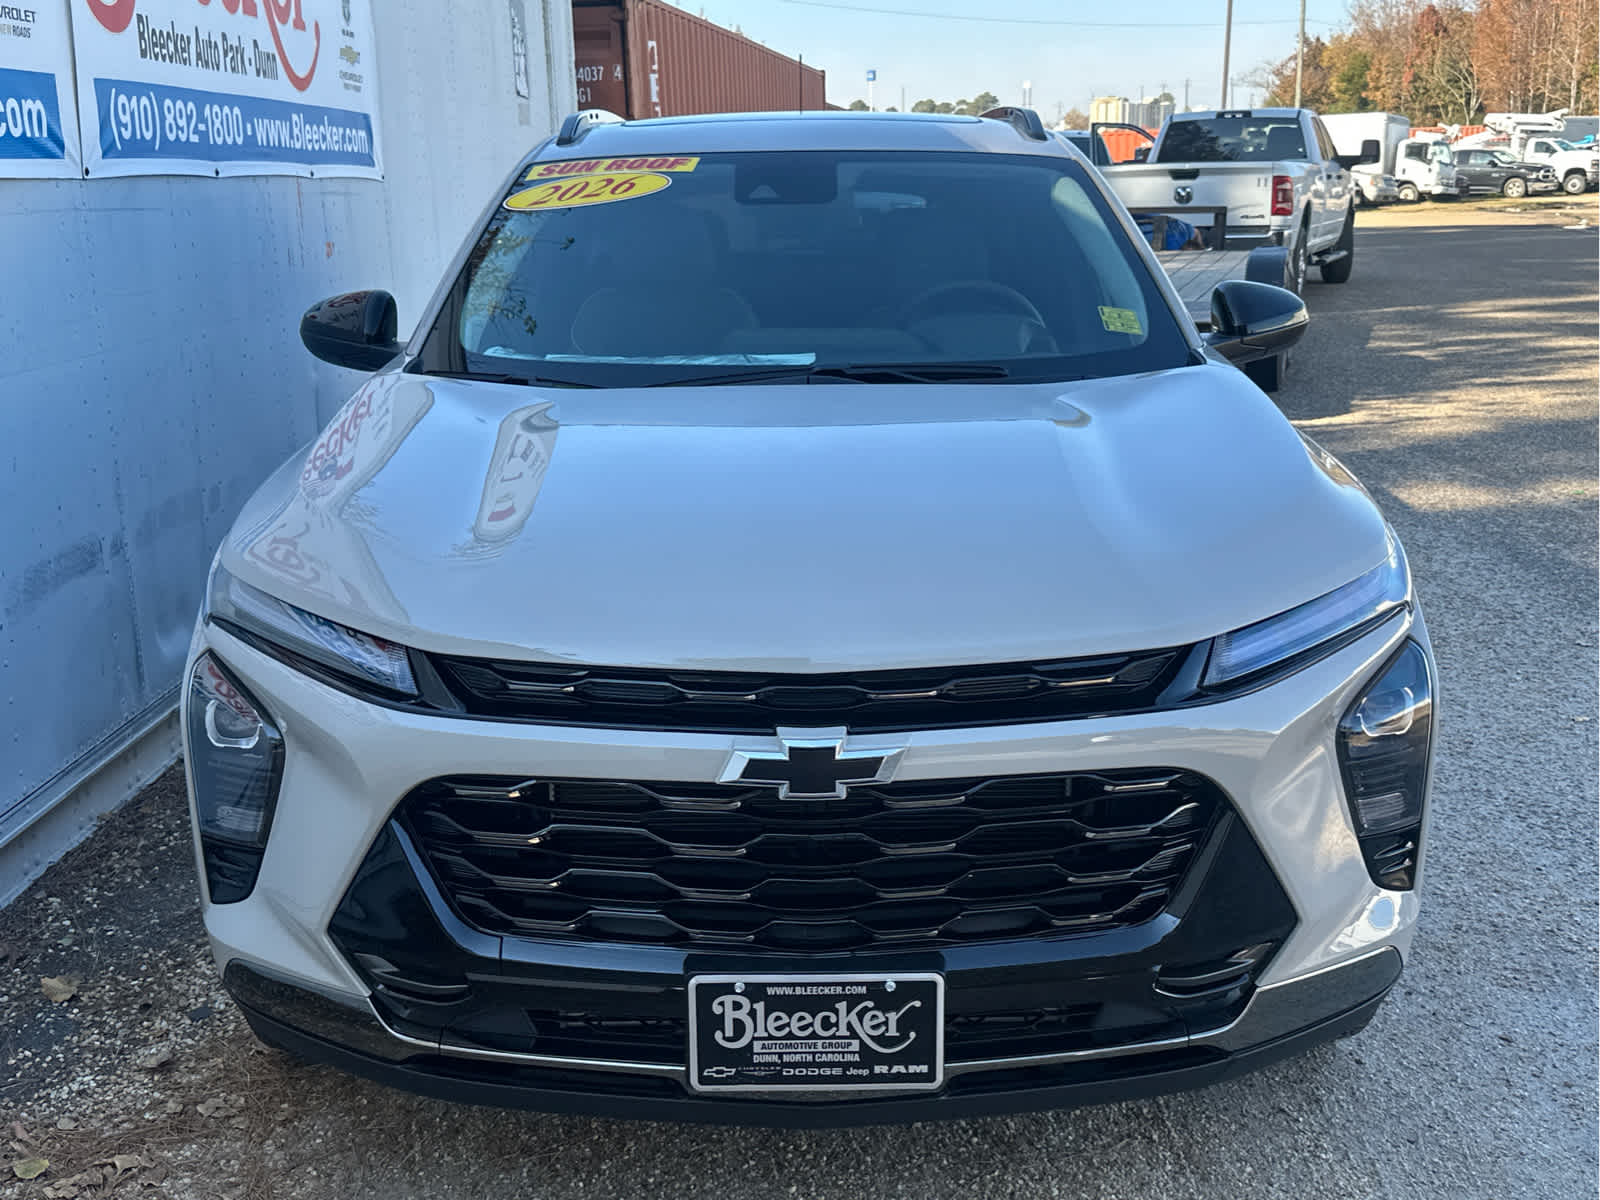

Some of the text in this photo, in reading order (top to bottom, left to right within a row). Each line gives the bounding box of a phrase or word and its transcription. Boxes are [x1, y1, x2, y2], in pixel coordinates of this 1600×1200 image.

[136, 13, 192, 67] Bleecker
[195, 26, 220, 72] Auto
[221, 31, 248, 76] Park
[253, 39, 279, 80] Dunn
[110, 88, 370, 155] (910) 892-1800 www.Bleecker.com
[537, 157, 691, 177] SUN ROOF
[527, 174, 648, 207] 2026
[766, 985, 867, 996] WWW.BLEECKER.COM
[711, 994, 922, 1054] Bleecker
[760, 1041, 853, 1051] AUTOMOTIVE GROUP
[753, 1053, 861, 1064] DUNN, NORTH CAROLINA
[782, 1064, 929, 1077] DODGE Jeep RAM
